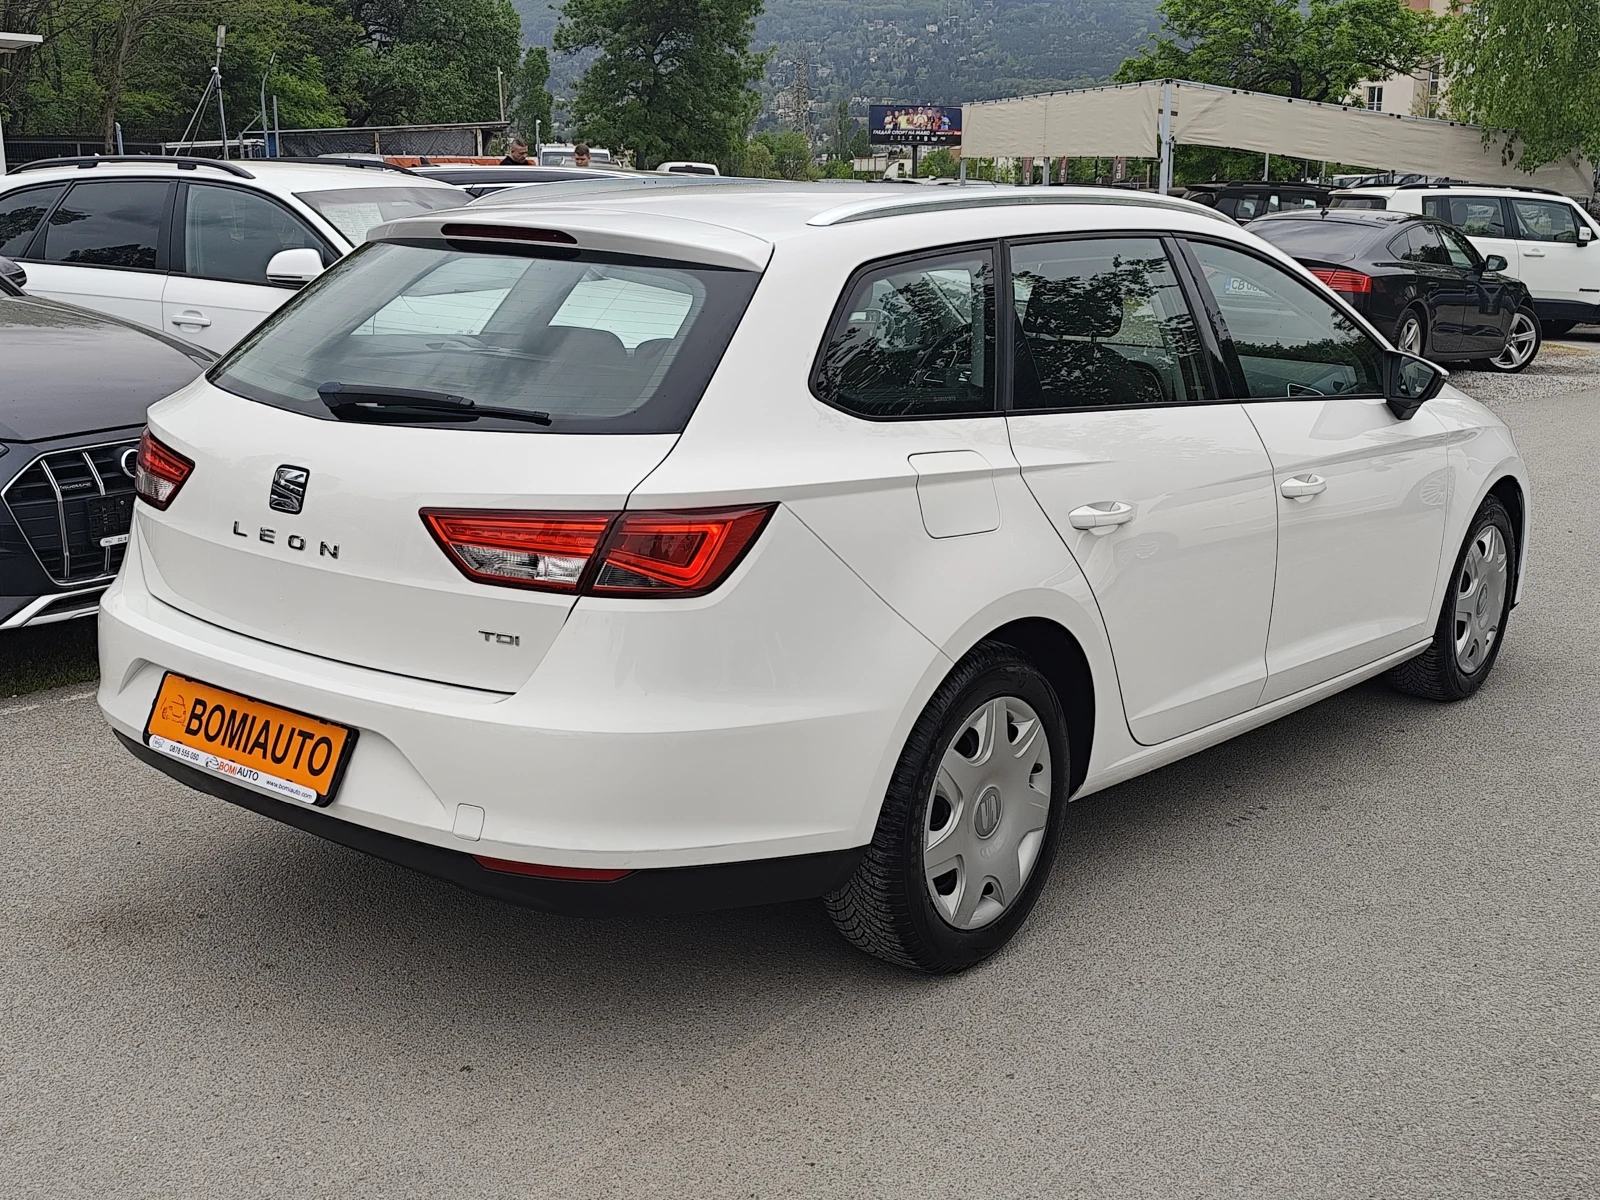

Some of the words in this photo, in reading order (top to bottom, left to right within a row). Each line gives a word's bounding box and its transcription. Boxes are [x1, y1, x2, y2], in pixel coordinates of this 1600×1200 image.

[233, 520, 339, 560] LEON
[478, 630, 520, 647] TDI
[169, 744, 181, 755] 0878
[185, 697, 333, 777] BOMIAUTO
